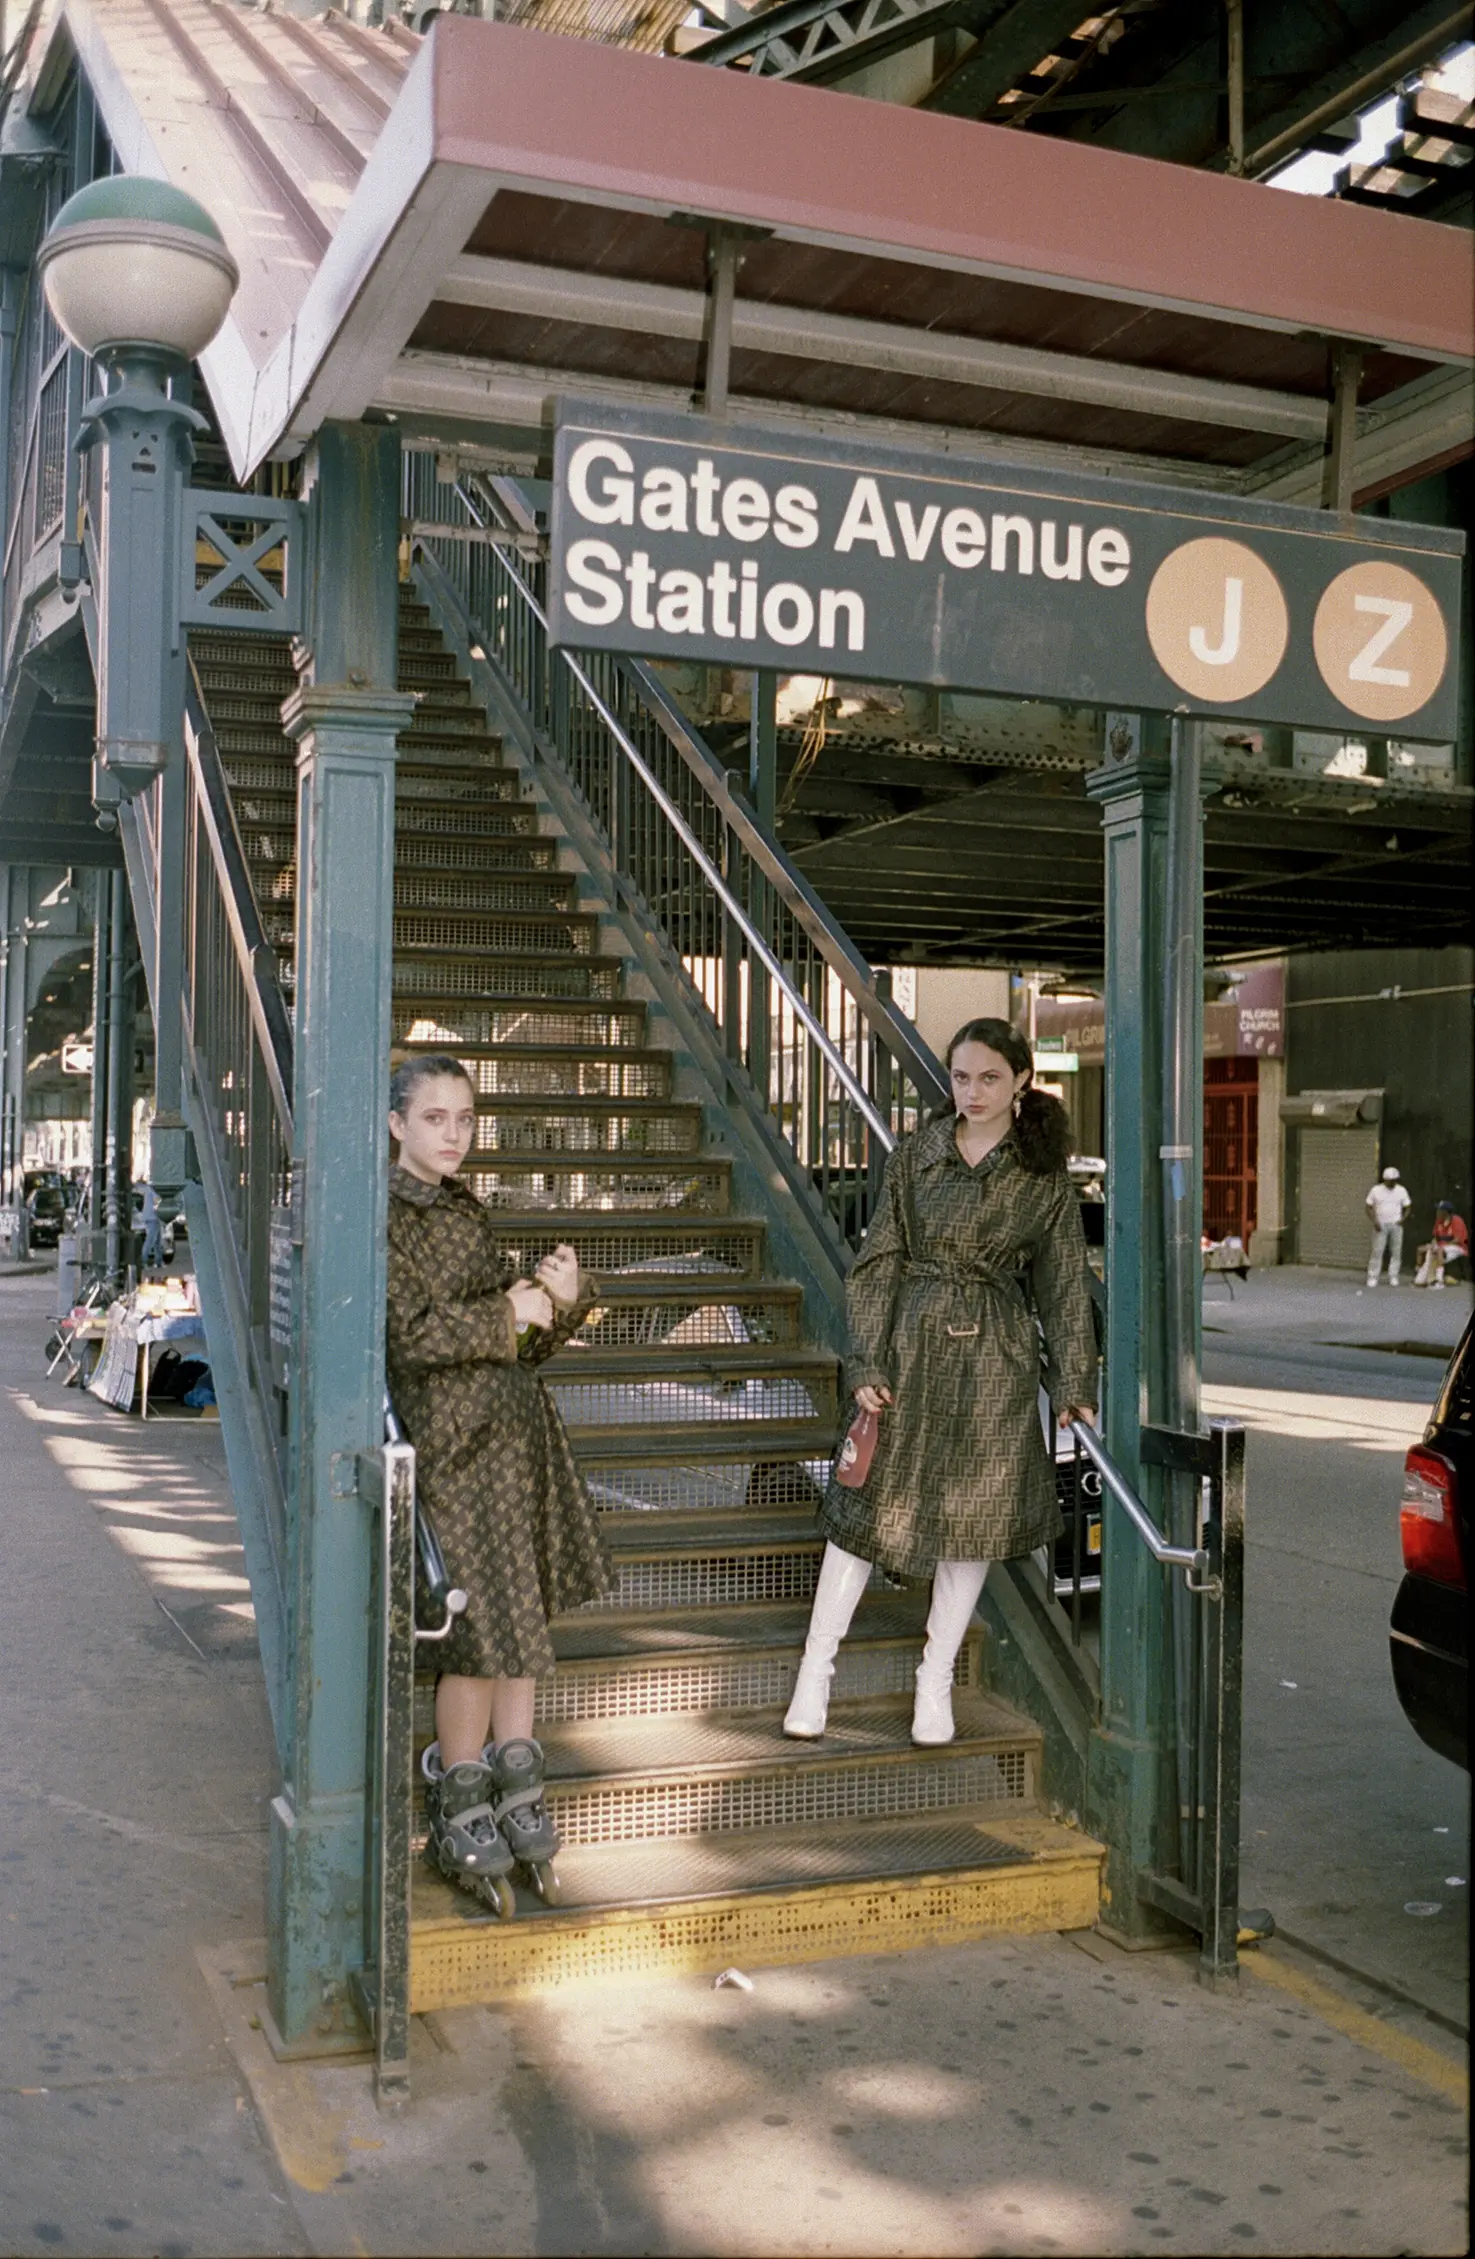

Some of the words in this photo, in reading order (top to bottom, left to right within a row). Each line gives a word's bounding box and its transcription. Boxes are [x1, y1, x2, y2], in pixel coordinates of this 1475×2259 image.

[567, 438, 820, 548] Gates
[834, 477, 1131, 587] Avenue
[564, 538, 866, 652] Station
[1188, 577, 1244, 667] J
[1348, 594, 1414, 688] Z
